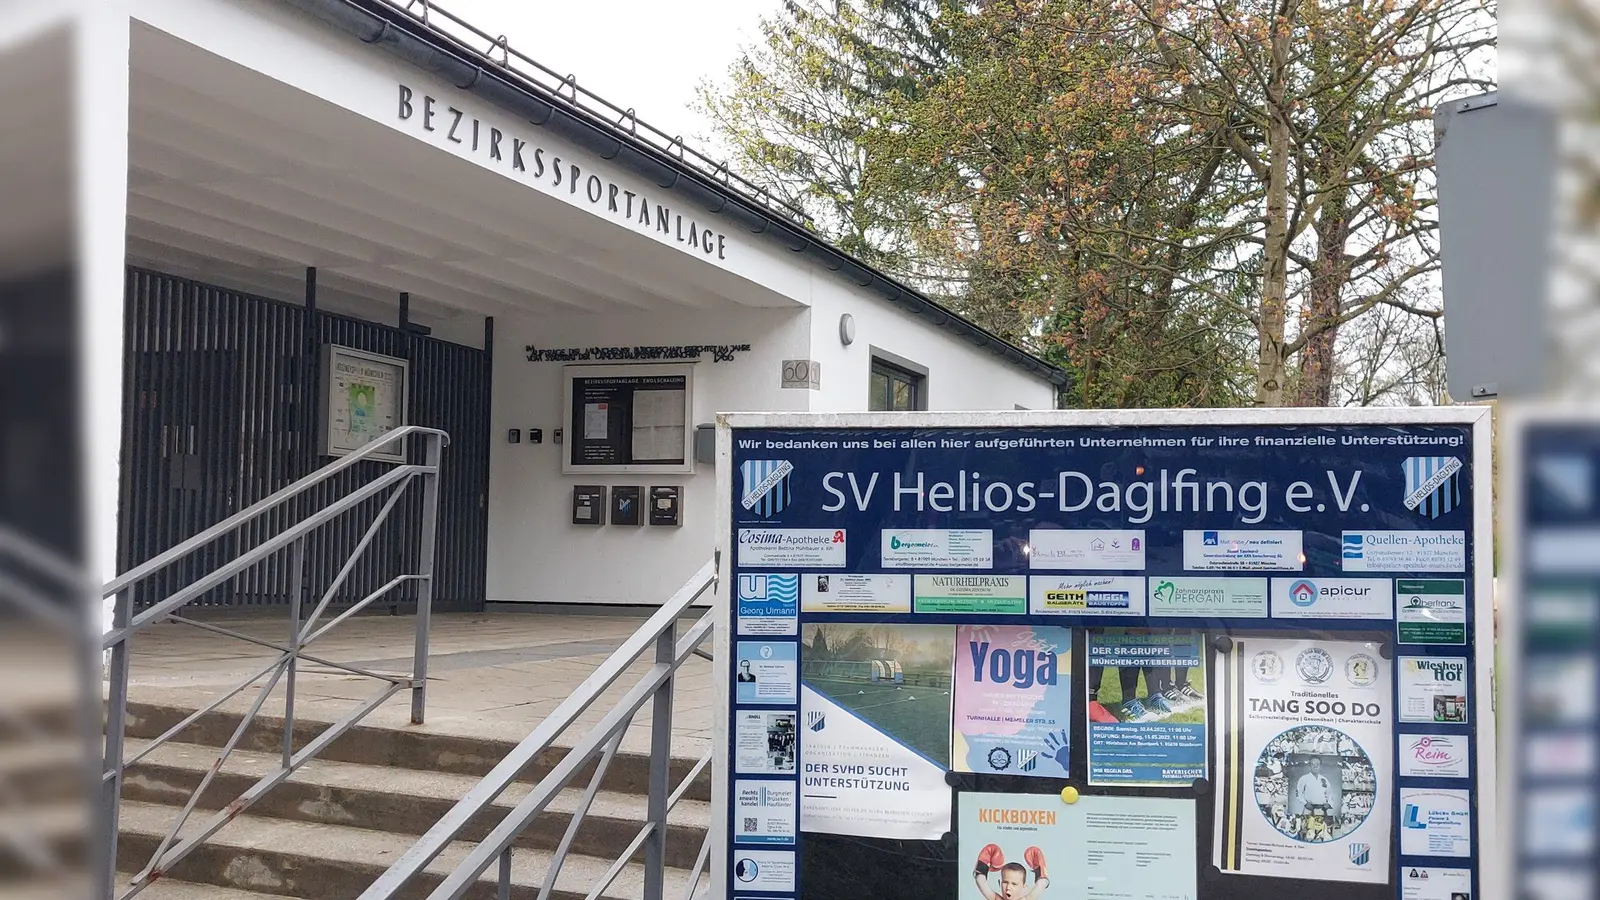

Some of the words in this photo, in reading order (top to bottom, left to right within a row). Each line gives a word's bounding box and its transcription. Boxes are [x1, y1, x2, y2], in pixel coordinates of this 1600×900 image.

[398, 84, 727, 260] BEZIRKSSPORTANLAGE
[783, 361, 809, 381] 60
[738, 439, 762, 449] Wir
[765, 439, 838, 449] bedanken
[842, 441, 869, 449] uns
[873, 439, 896, 449] bei
[900, 439, 937, 449] allen
[941, 438, 971, 448] hier
[974, 438, 1075, 450] aufgeführten
[1079, 437, 1186, 448] Unternehmen
[1191, 437, 1214, 447] für
[1218, 436, 1250, 446] ihre
[1254, 436, 1337, 446] finanzielle
[1341, 435, 1464, 447] Unterstützung!
[822, 472, 880, 512] SV
[894, 469, 1268, 524] Helios-Daglfing
[1285, 470, 1370, 513] e.V.
[740, 530, 830, 544] Cosima-Apotheke
[1366, 534, 1464, 545] Quellen-Apotheke
[932, 576, 1010, 587] NATURHEILPRAXIS
[1047, 593, 1084, 601] GEITH
[1088, 593, 1127, 601] NIGGL
[1320, 585, 1371, 598] apicur
[1174, 594, 1224, 603] PERGANI
[740, 607, 764, 616] Georg
[1092, 647, 1112, 655] DER
[1114, 647, 1170, 655] SR-GRUPPE
[969, 641, 1058, 690] Yoga
[1091, 658, 1199, 666] MÜNCHEN-OST/EBERSBERG
[1291, 690, 1339, 699] Traditionelles
[1249, 698, 1300, 713] TANG
[1304, 700, 1346, 716] SOO
[1351, 702, 1381, 717] DO
[966, 714, 1001, 722] TURNHALLE
[1415, 747, 1451, 760] Reim
[805, 763, 829, 773] DER
[832, 764, 865, 775] SVHD
[867, 765, 909, 777] SUCHT
[804, 776, 911, 792] UNTERSTÜTZUNG
[979, 808, 1056, 826] KICKBOXEN
